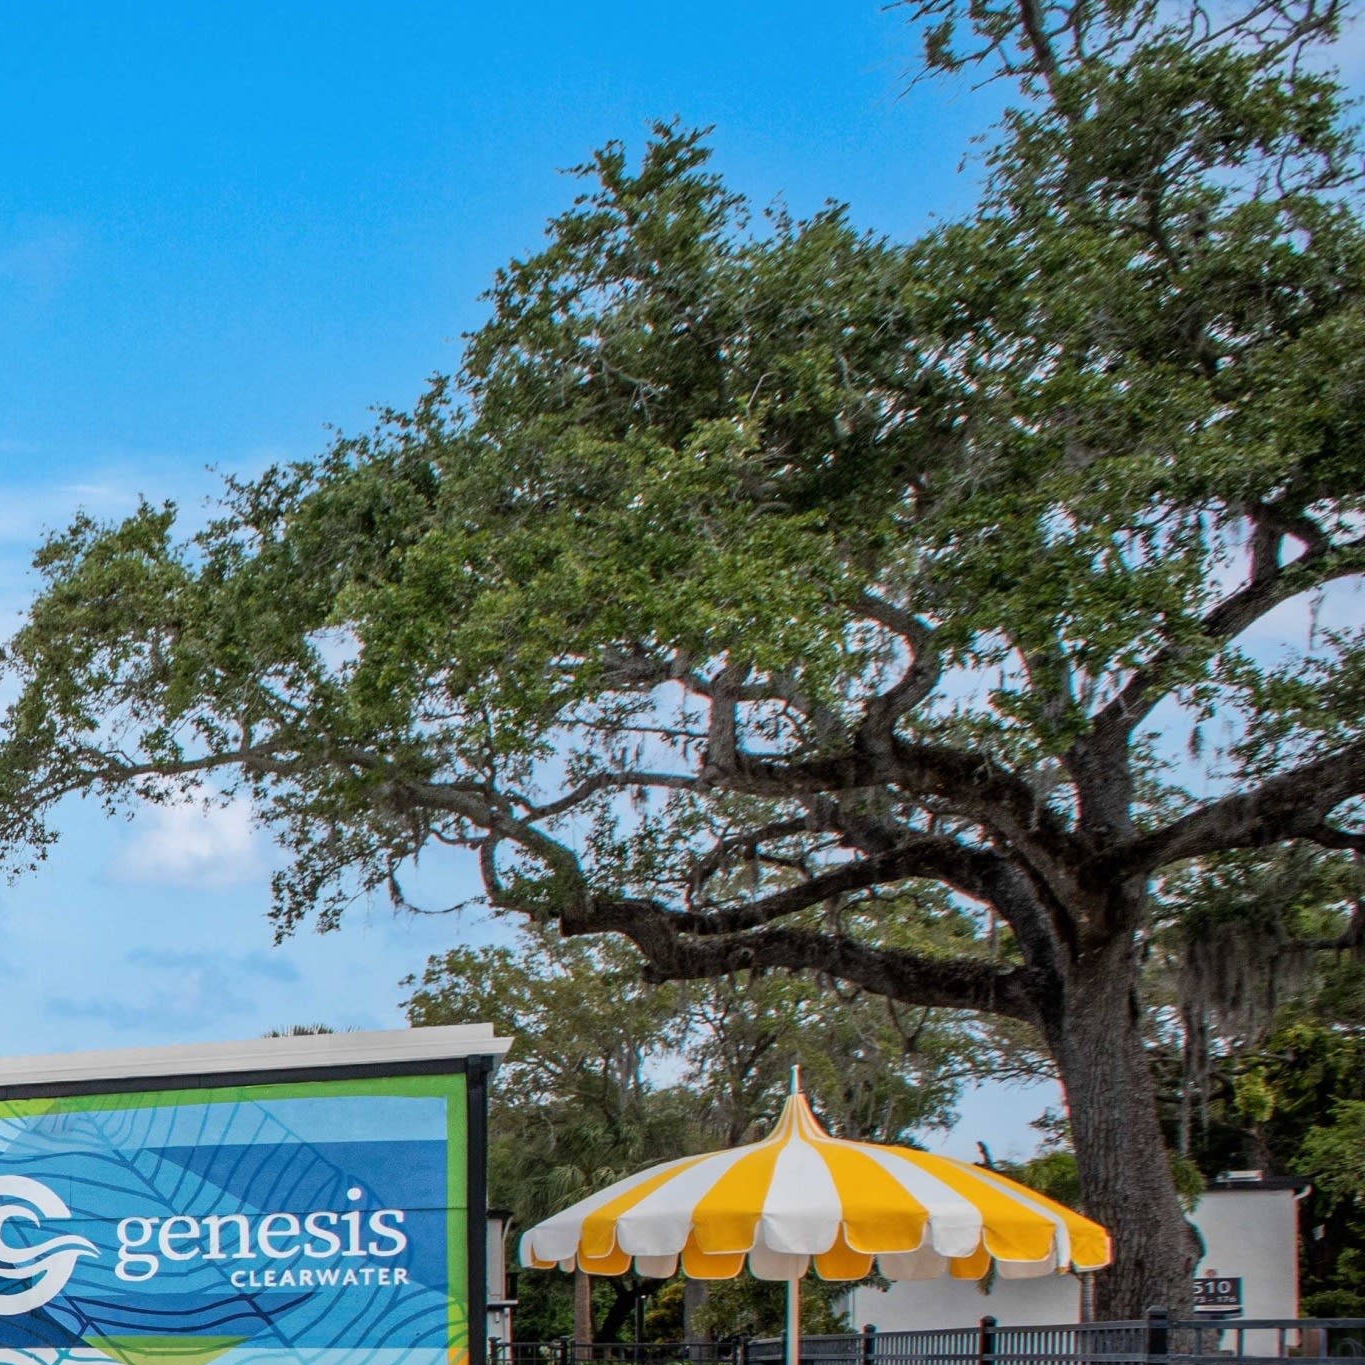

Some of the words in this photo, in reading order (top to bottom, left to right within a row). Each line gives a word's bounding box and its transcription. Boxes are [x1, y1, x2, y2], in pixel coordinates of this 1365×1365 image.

[115, 1187, 407, 1282] genesis
[231, 1268, 410, 1288] CLEARWATER
[1192, 1281, 1232, 1294] 510
